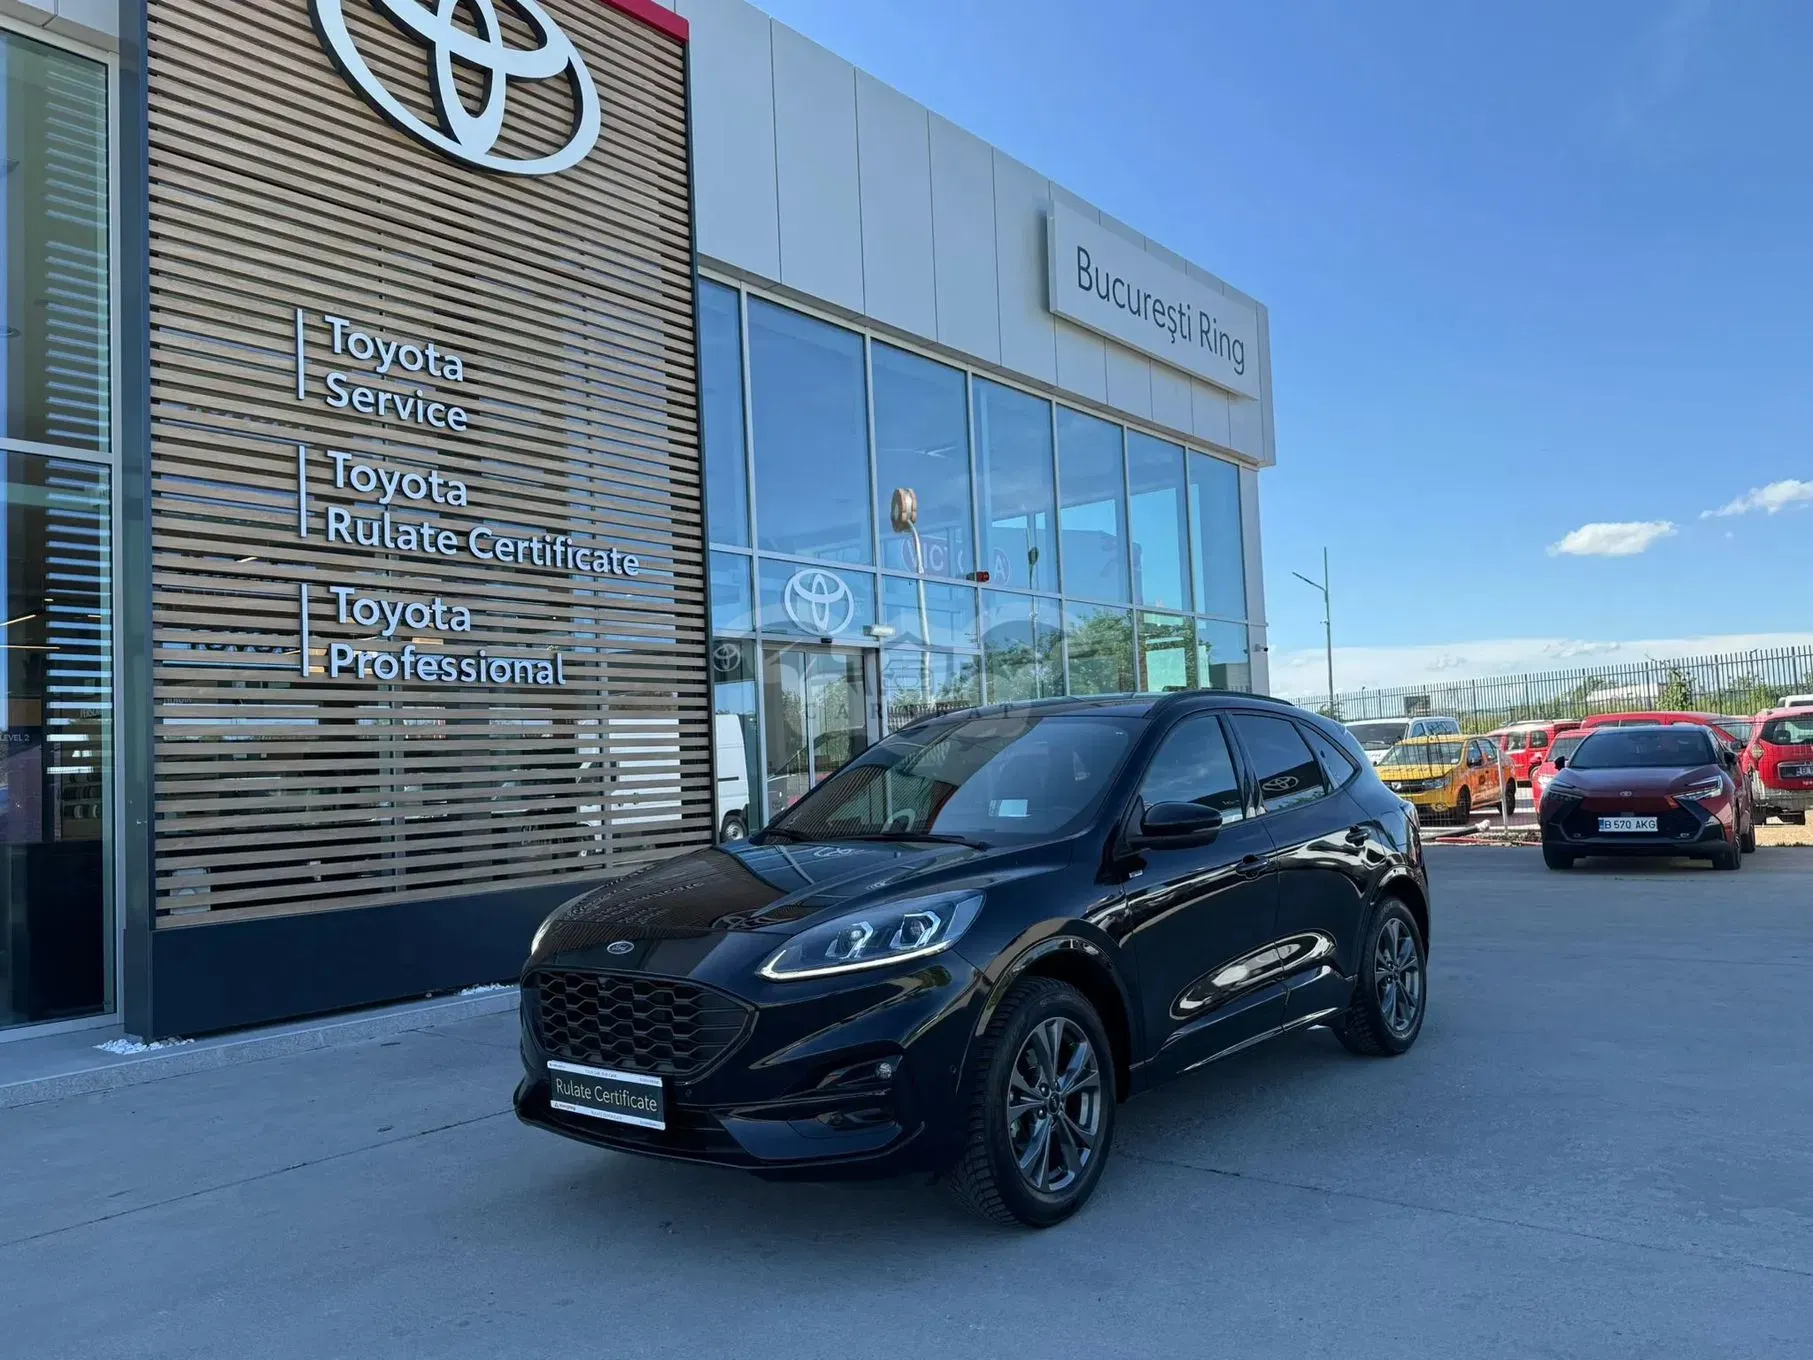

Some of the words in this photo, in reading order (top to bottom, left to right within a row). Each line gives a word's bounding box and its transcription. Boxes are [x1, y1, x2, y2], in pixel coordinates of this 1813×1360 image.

[324, 314, 464, 382] Toyota
[1199, 311, 1245, 376] Ring
[325, 372, 468, 432] Service
[326, 449, 468, 507] Toyota
[326, 506, 458, 555] Rulate
[468, 525, 641, 576] Certificate
[329, 585, 472, 637] Toyota
[329, 642, 566, 685] Professional
[1604, 820, 1611, 829] B
[1613, 820, 1632, 829] 570
[1635, 820, 1656, 829] AKG
[556, 1078, 592, 1100] Rulate
[594, 1085, 657, 1112] Certificate
